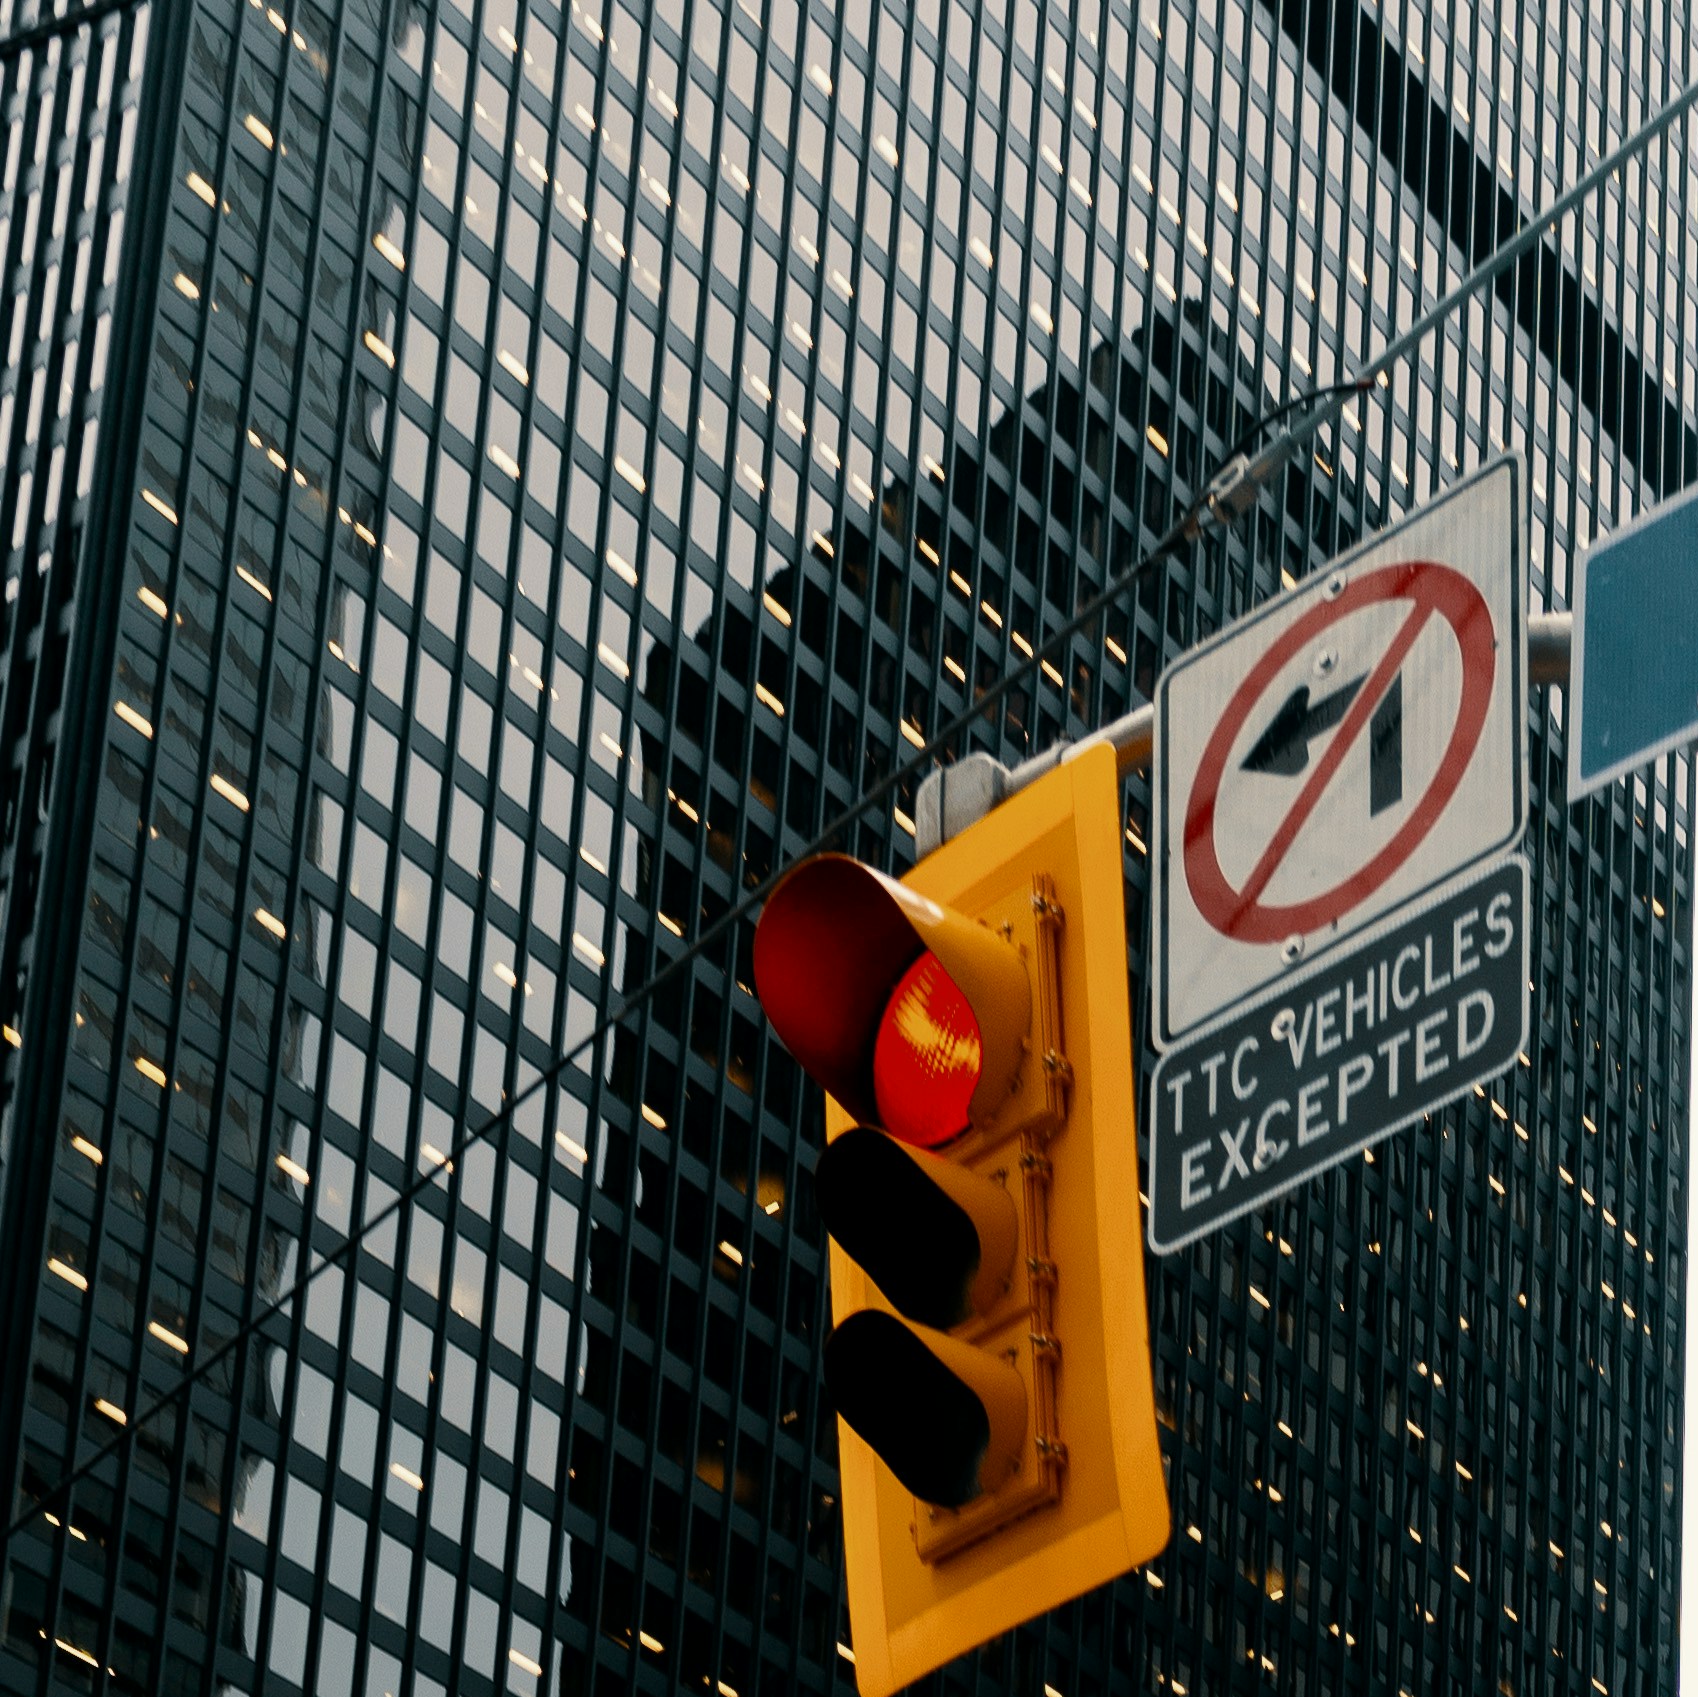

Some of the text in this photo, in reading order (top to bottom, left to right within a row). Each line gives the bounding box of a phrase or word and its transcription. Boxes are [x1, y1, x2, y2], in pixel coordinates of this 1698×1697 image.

[1166, 890, 1515, 1134] TTC VEHICLES
[1178, 988, 1496, 1212] EXCEPTED
